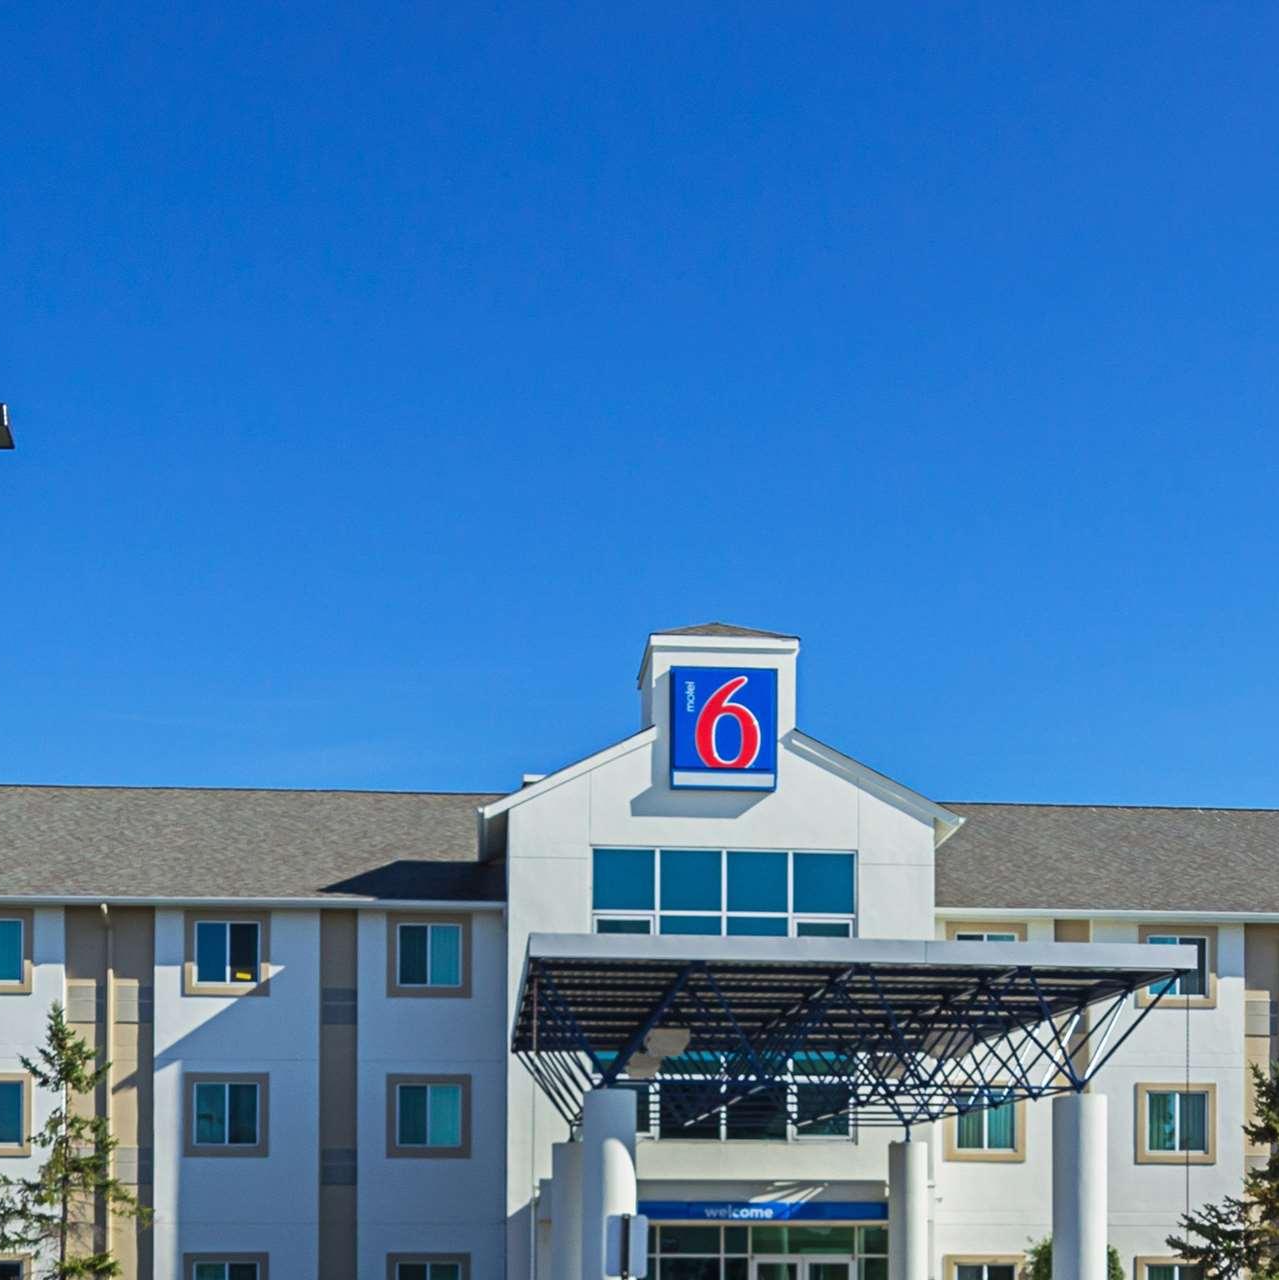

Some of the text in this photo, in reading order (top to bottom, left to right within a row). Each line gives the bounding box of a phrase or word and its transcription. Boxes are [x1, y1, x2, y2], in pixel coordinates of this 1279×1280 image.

[685, 675, 761, 769] motel 6
[704, 1204, 774, 1219] welcome
